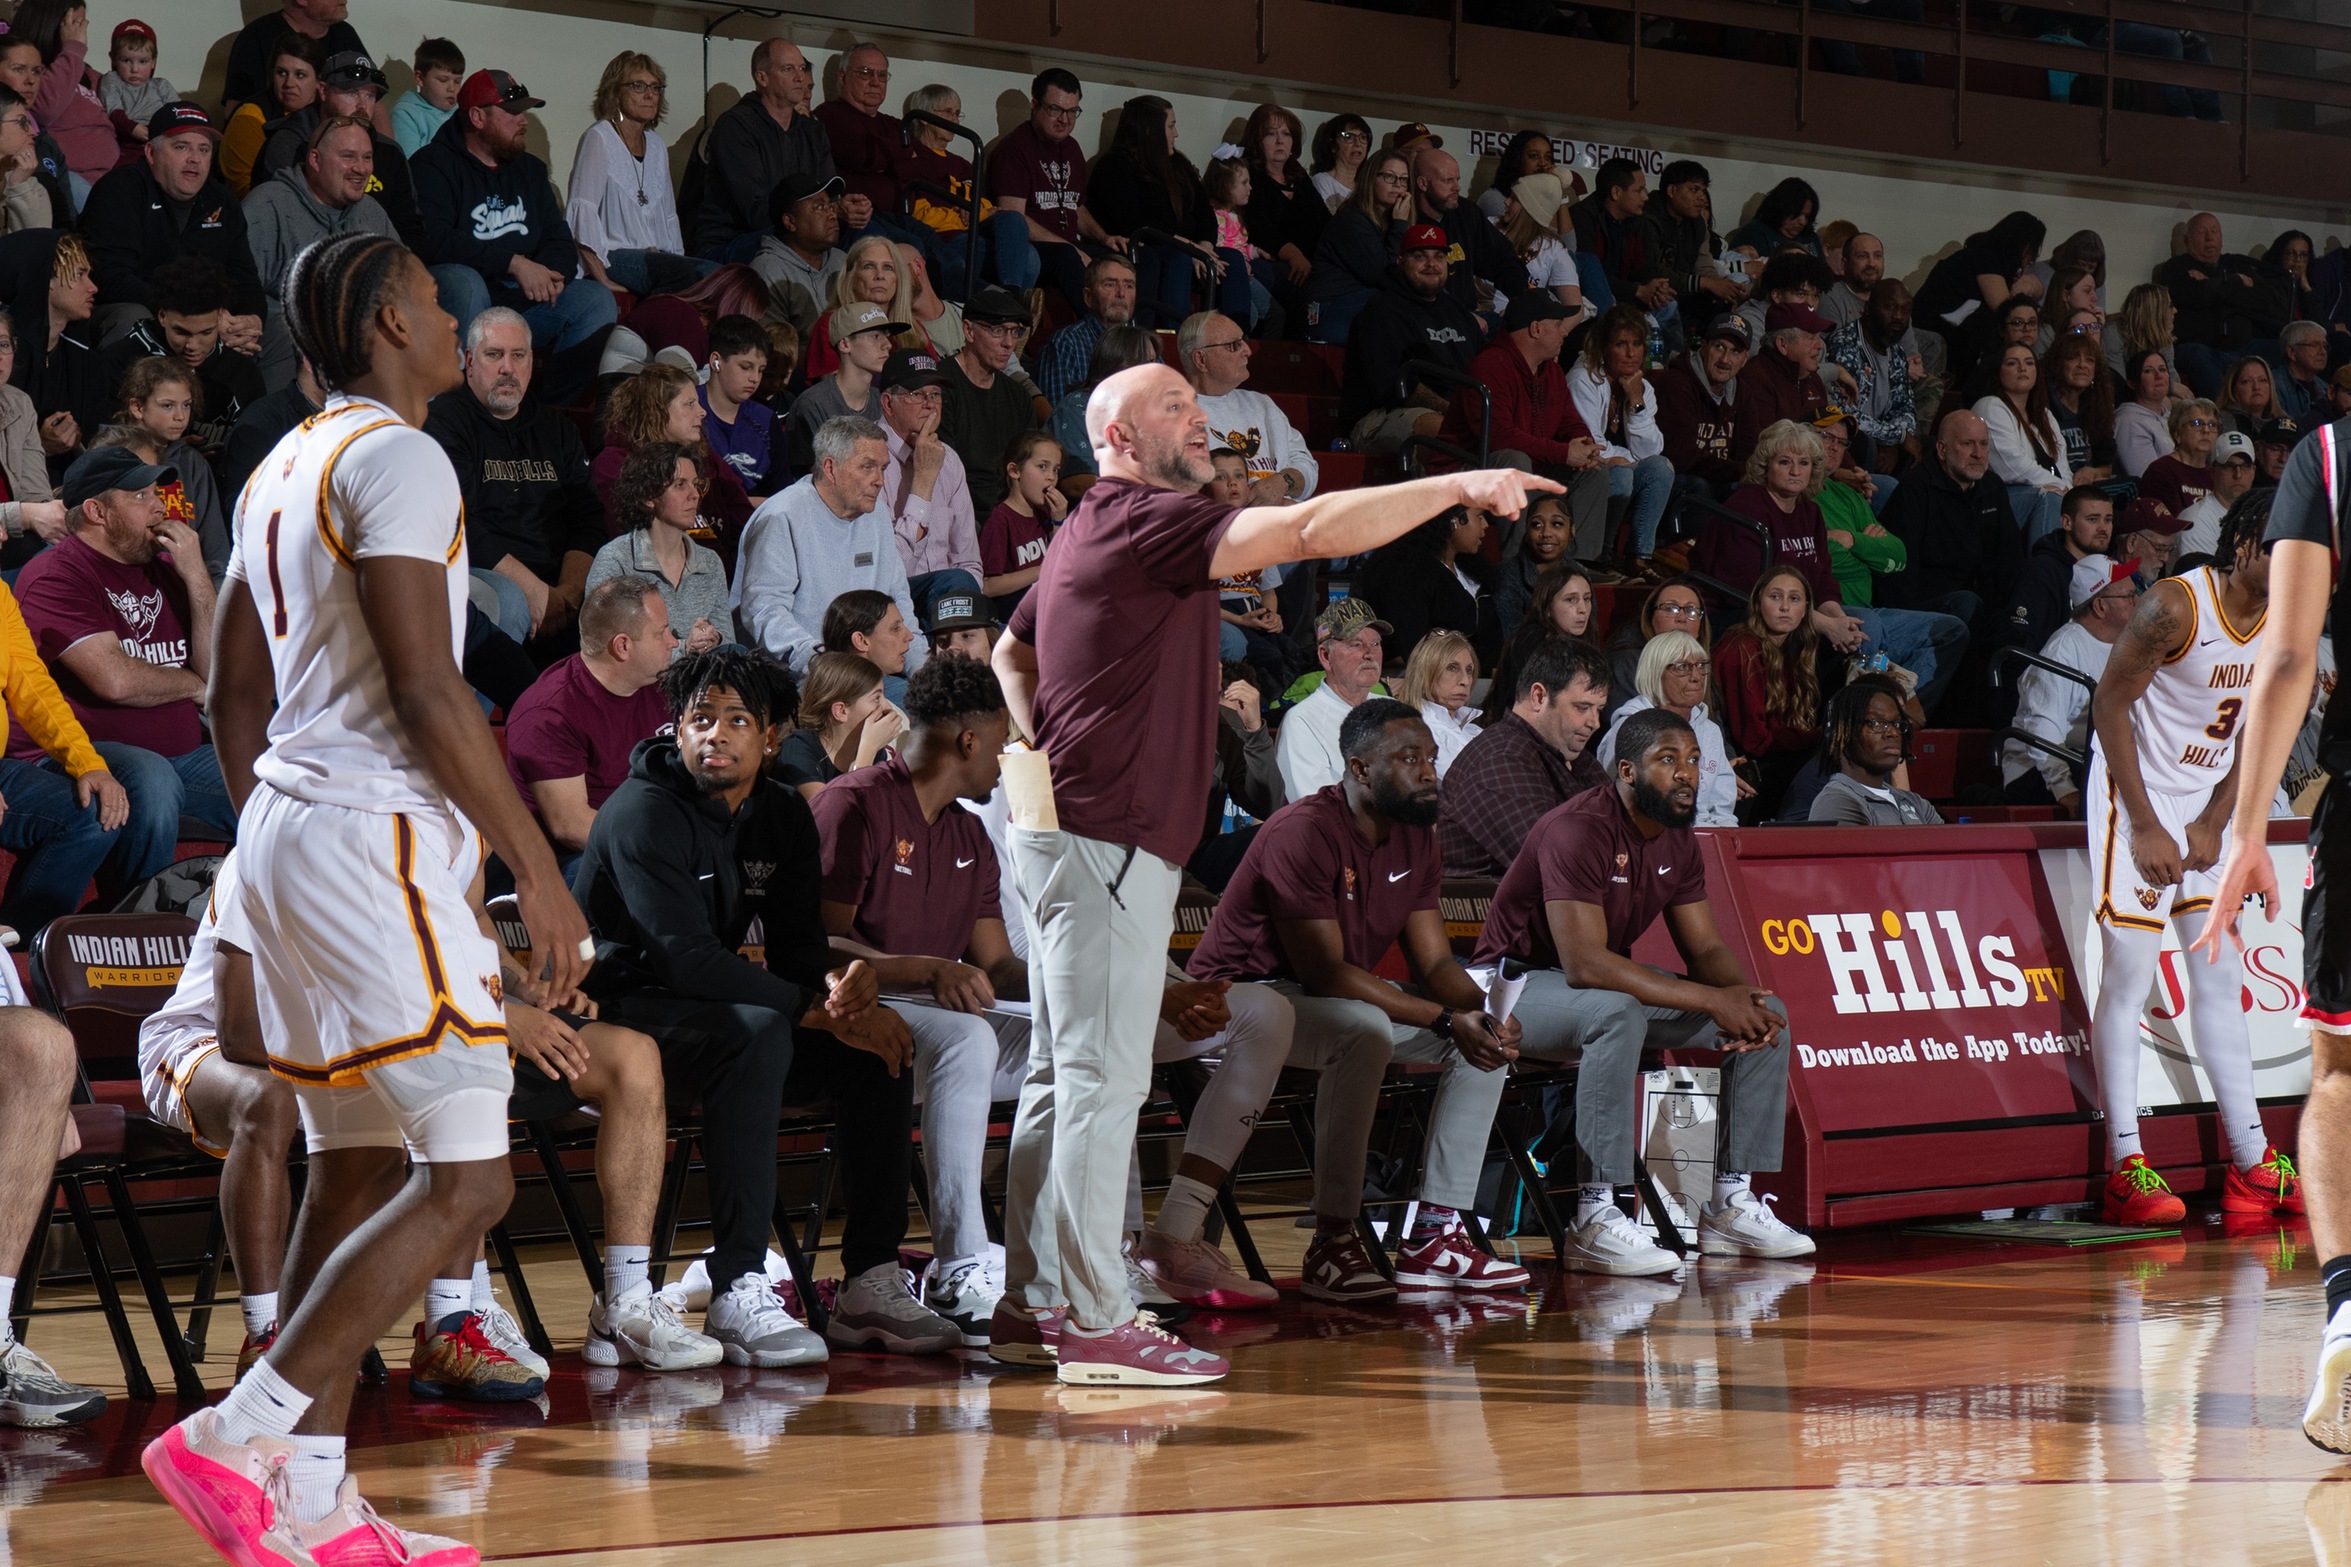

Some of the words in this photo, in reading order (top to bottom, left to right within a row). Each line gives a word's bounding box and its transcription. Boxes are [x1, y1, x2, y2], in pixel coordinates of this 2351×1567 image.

[1470, 130, 1576, 165] RESED
[2229, 434, 2242, 445] S
[265, 507, 288, 641] 1
[145, 639, 188, 664] HILLS
[2207, 663, 2255, 689] INDIA
[2204, 696, 2243, 742] 3
[67, 934, 141, 966] INDIAN
[495, 921, 530, 949] IND
[93, 970, 180, 983] WARRIOR
[1761, 918, 1815, 955] GO
[1807, 909, 2029, 1014] Hills
[2023, 967, 2065, 1002] TV
[1796, 1039, 1918, 1069] Download
[1920, 1036, 1960, 1062] the
[1964, 1034, 2010, 1063] App
[2012, 1028, 2091, 1056] Today!
